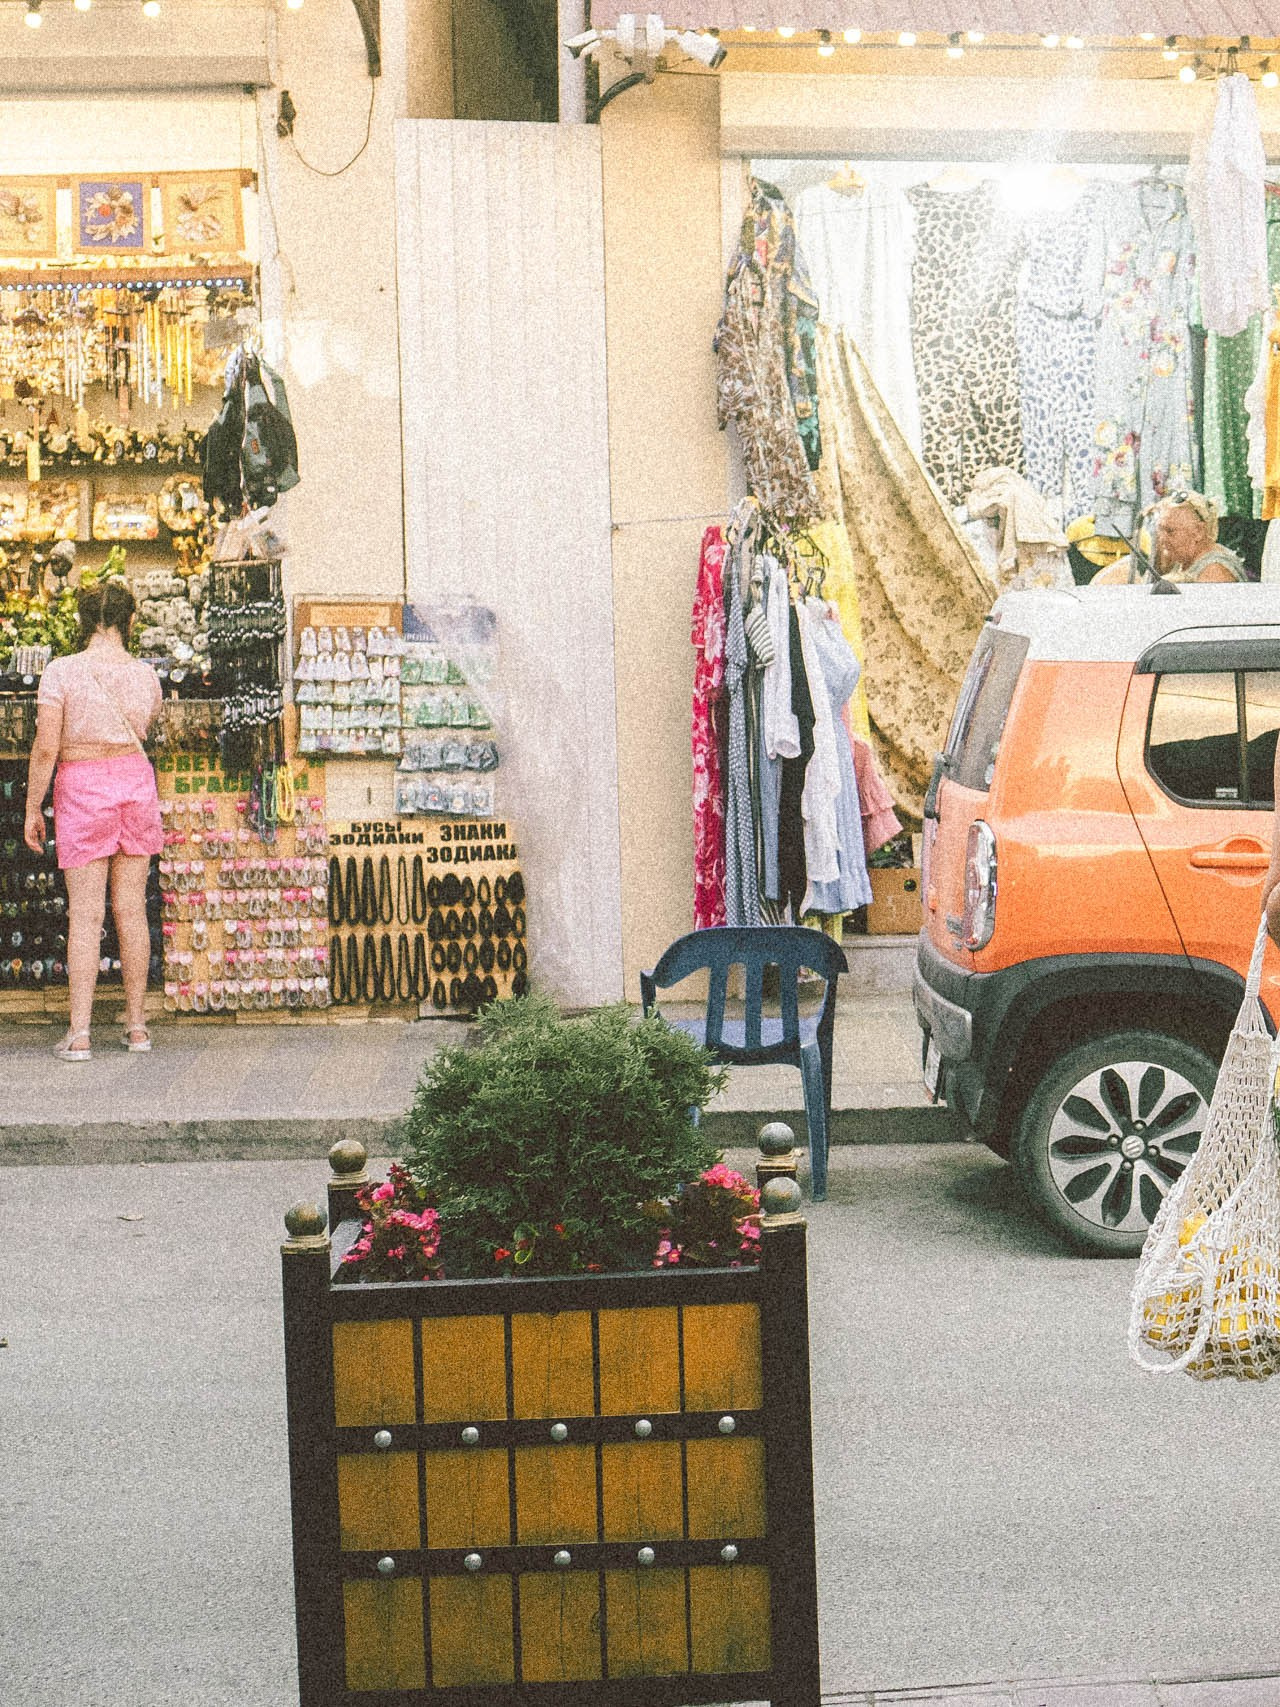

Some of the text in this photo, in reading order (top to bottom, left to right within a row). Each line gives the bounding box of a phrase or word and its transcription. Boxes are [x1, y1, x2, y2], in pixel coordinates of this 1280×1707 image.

[351, 821, 402, 833] БУСЫ
[439, 823, 507, 842] ЗНАКИ
[329, 832, 424, 847] ЗОДИАКИ
